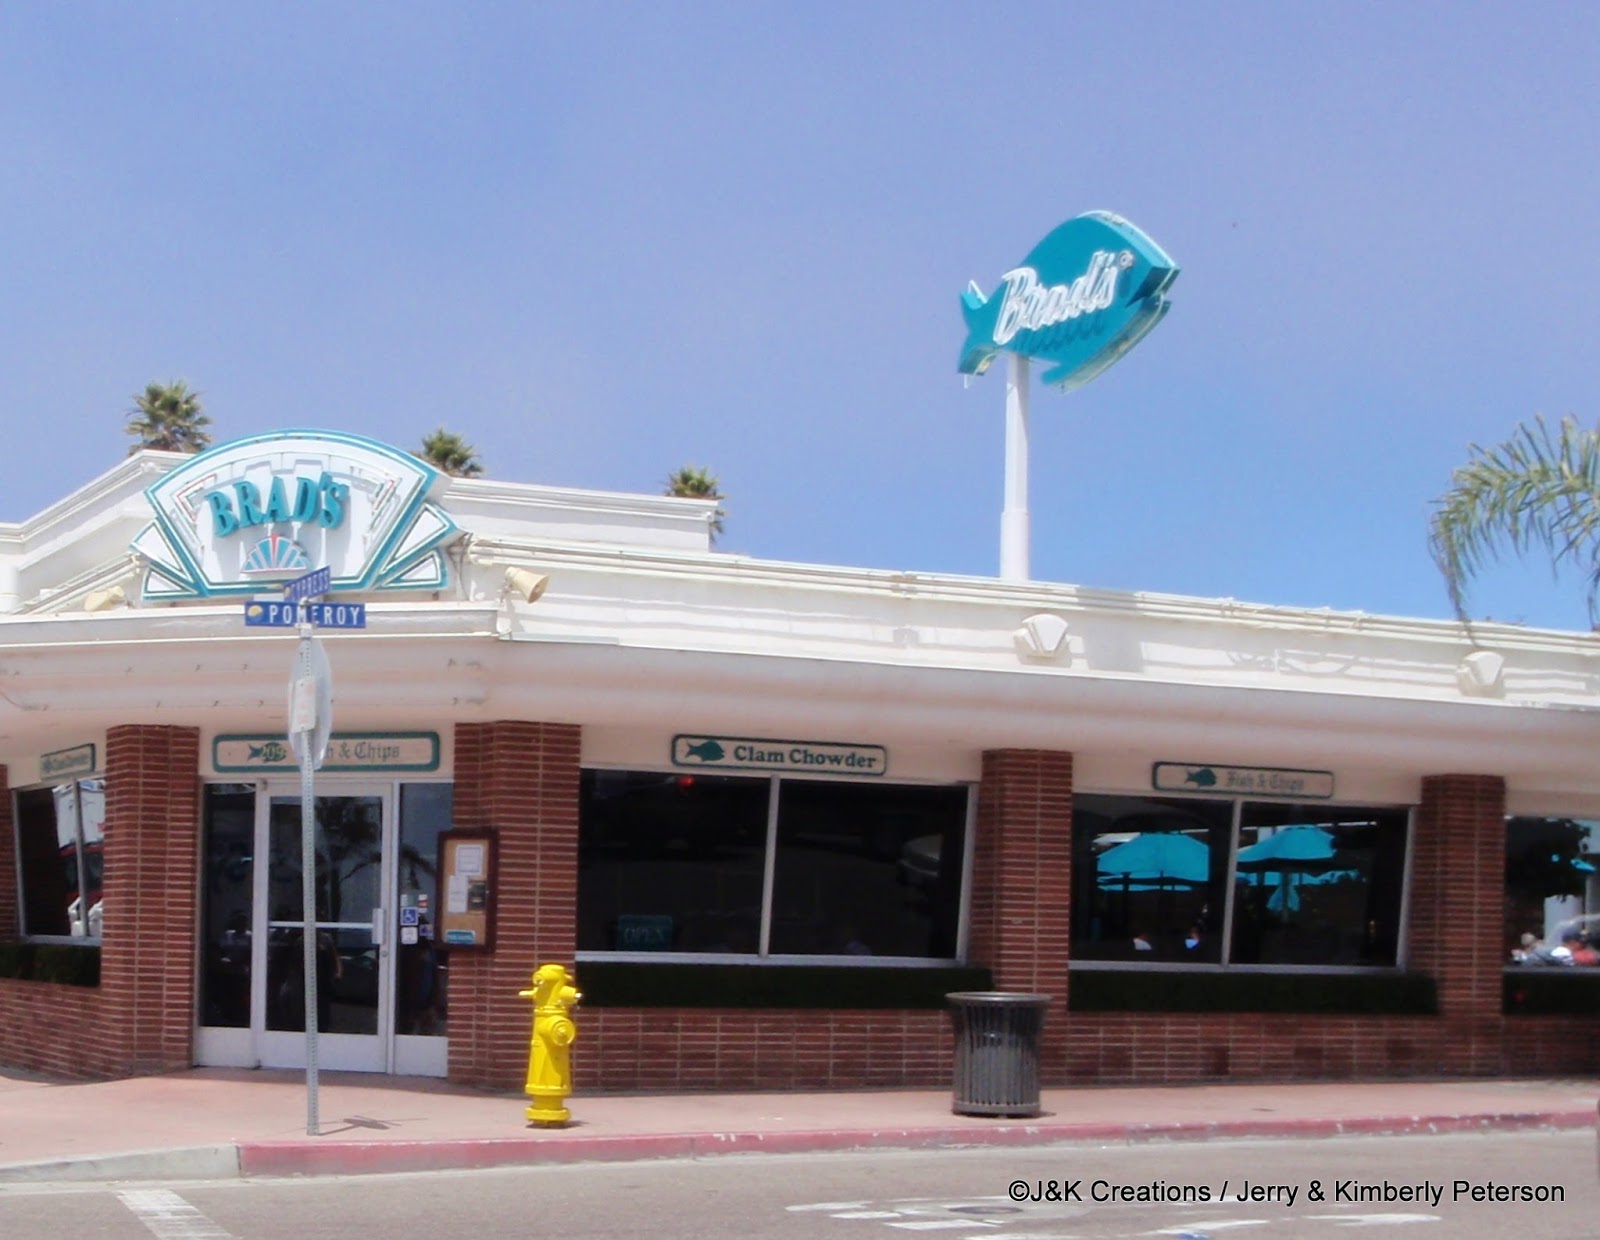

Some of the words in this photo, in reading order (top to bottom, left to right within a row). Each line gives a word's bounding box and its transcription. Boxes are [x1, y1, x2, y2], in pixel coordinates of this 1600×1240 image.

[204, 471, 350, 537] BRAD'S
[269, 605, 360, 625] POMEROY
[338, 743, 350, 760] &
[354, 741, 400, 763] Chips
[733, 746, 785, 763] Clam
[789, 748, 877, 768] Chowder
